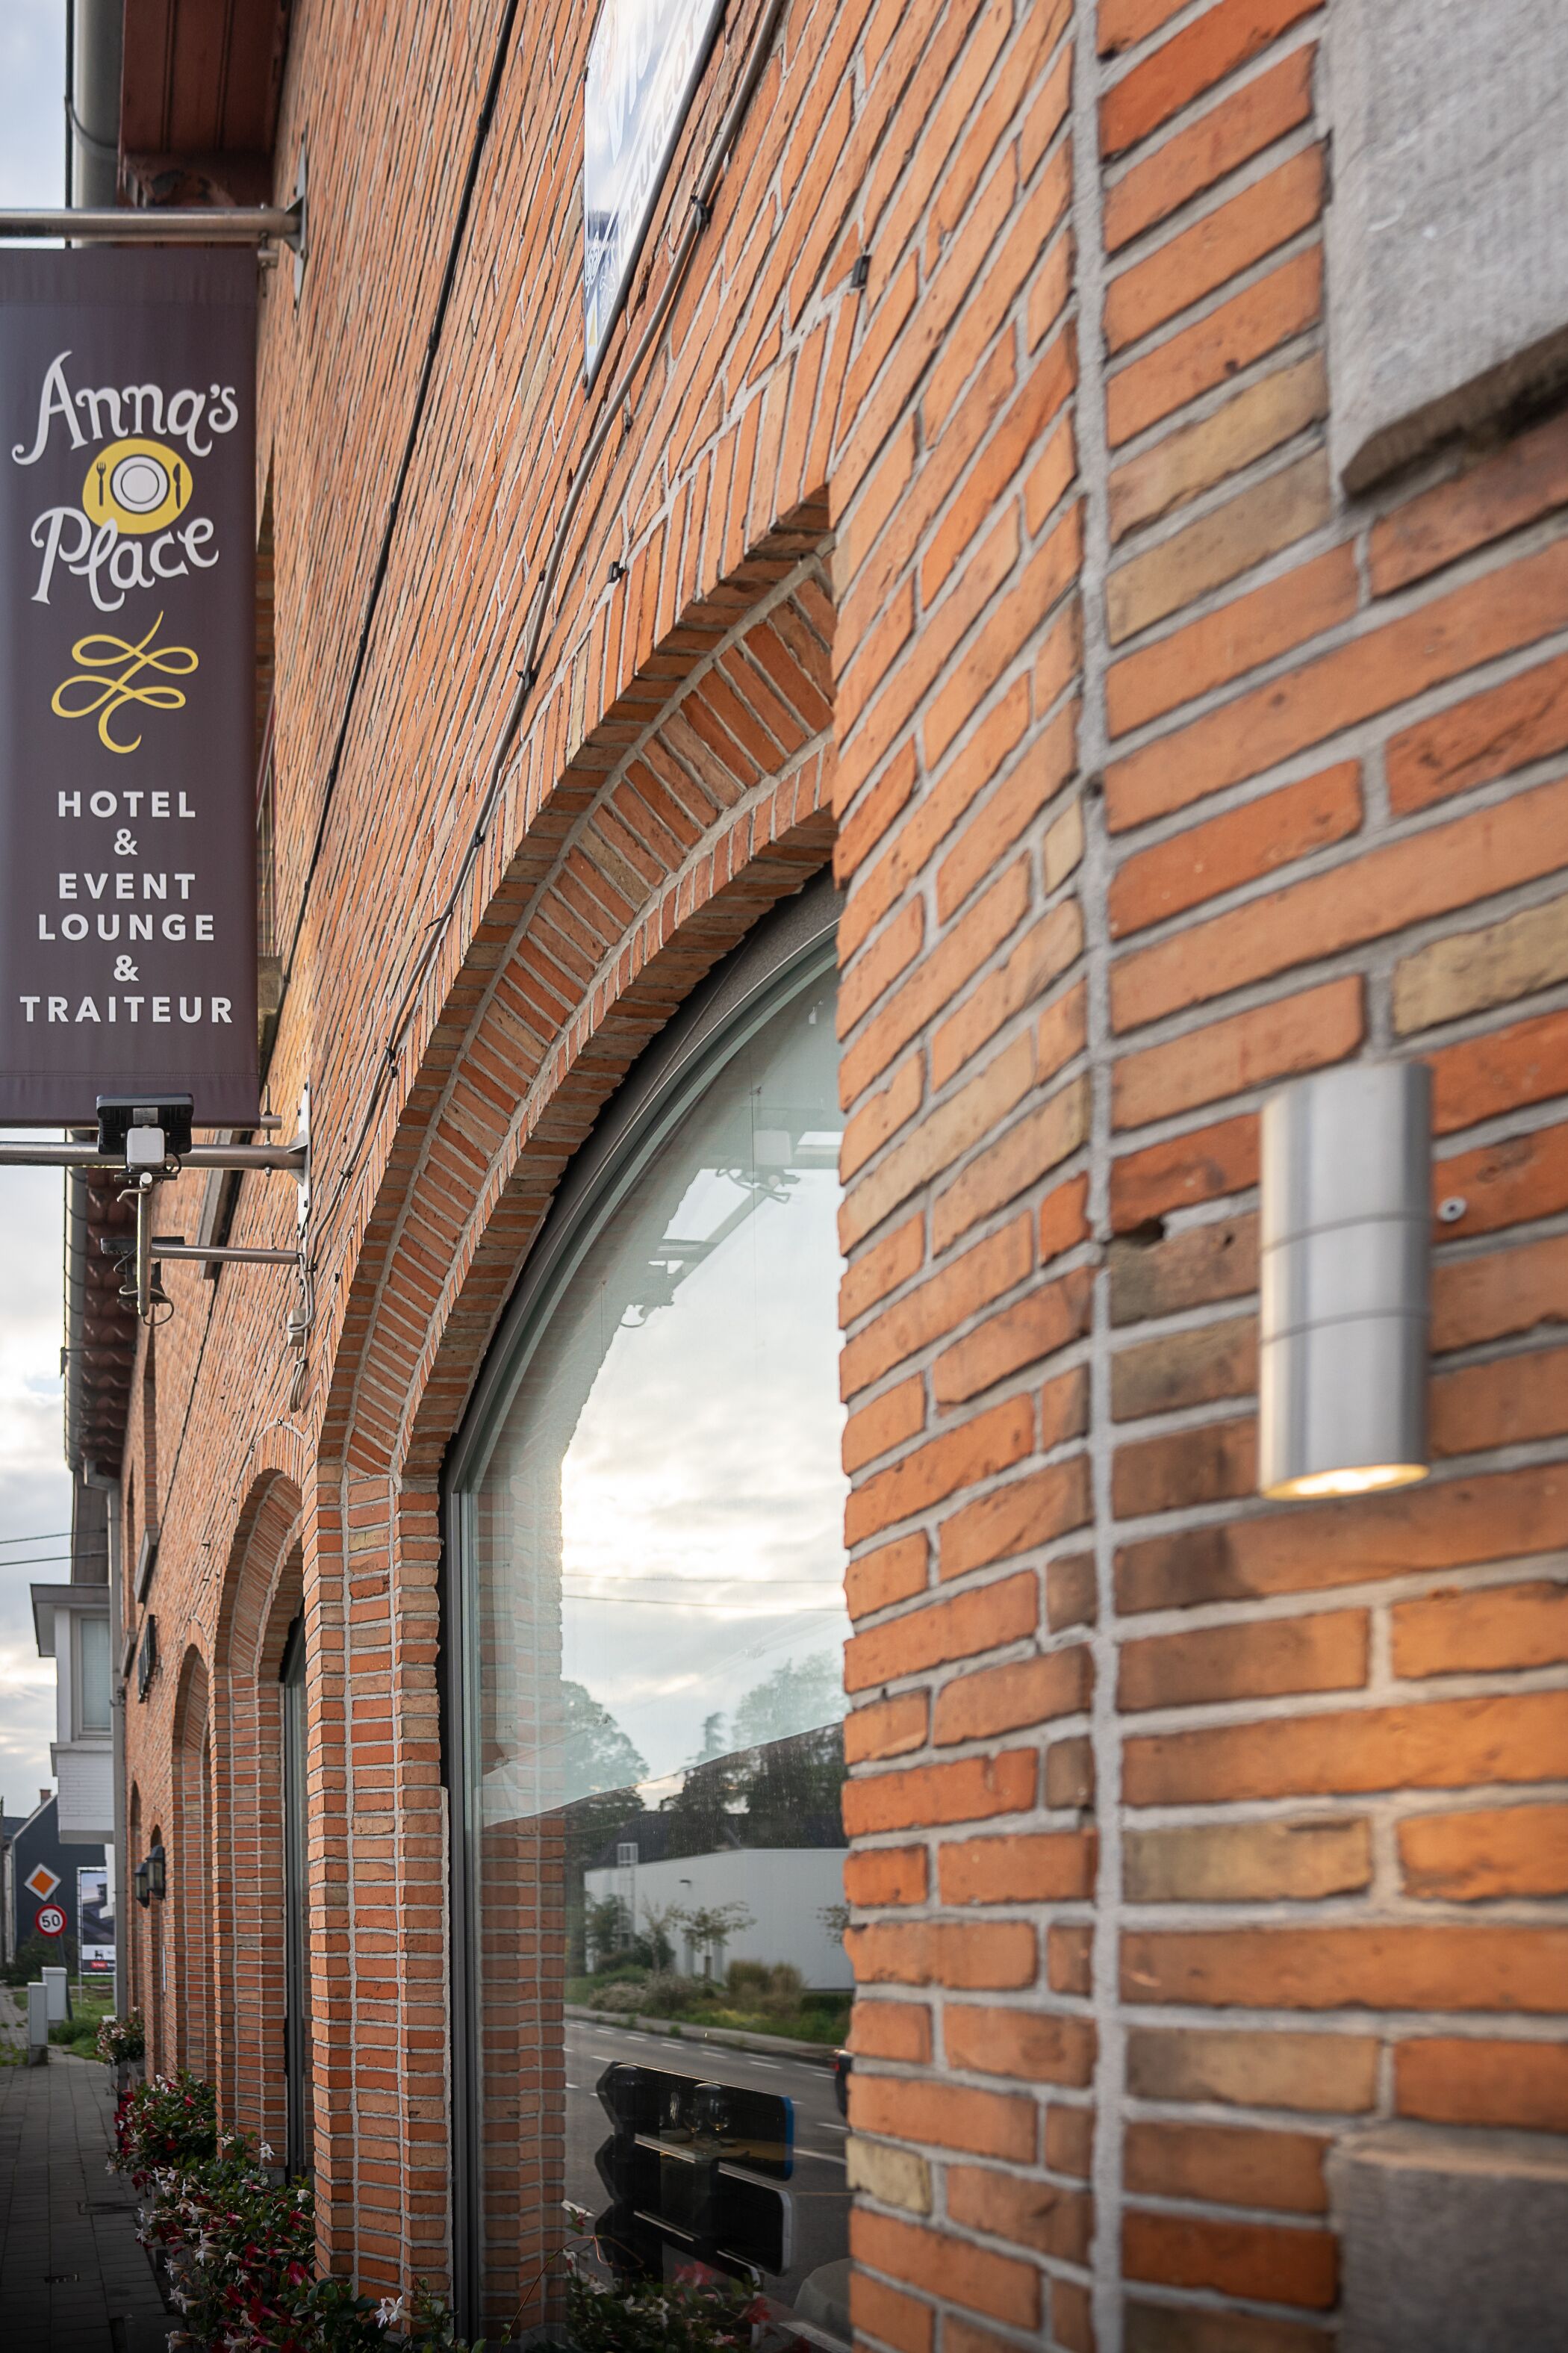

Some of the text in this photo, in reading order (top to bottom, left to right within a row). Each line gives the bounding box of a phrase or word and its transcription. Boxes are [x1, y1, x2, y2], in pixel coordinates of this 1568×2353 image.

[11, 350, 239, 465] Anna's
[30, 506, 220, 612] Place
[58, 790, 196, 818] HOTEL
[113, 828, 138, 856] &
[59, 873, 196, 900] EVENT
[39, 913, 214, 941] LOUNGE
[113, 954, 140, 982] &
[19, 996, 233, 1023] TRAITEUR
[42, 1915, 60, 1928] 50
